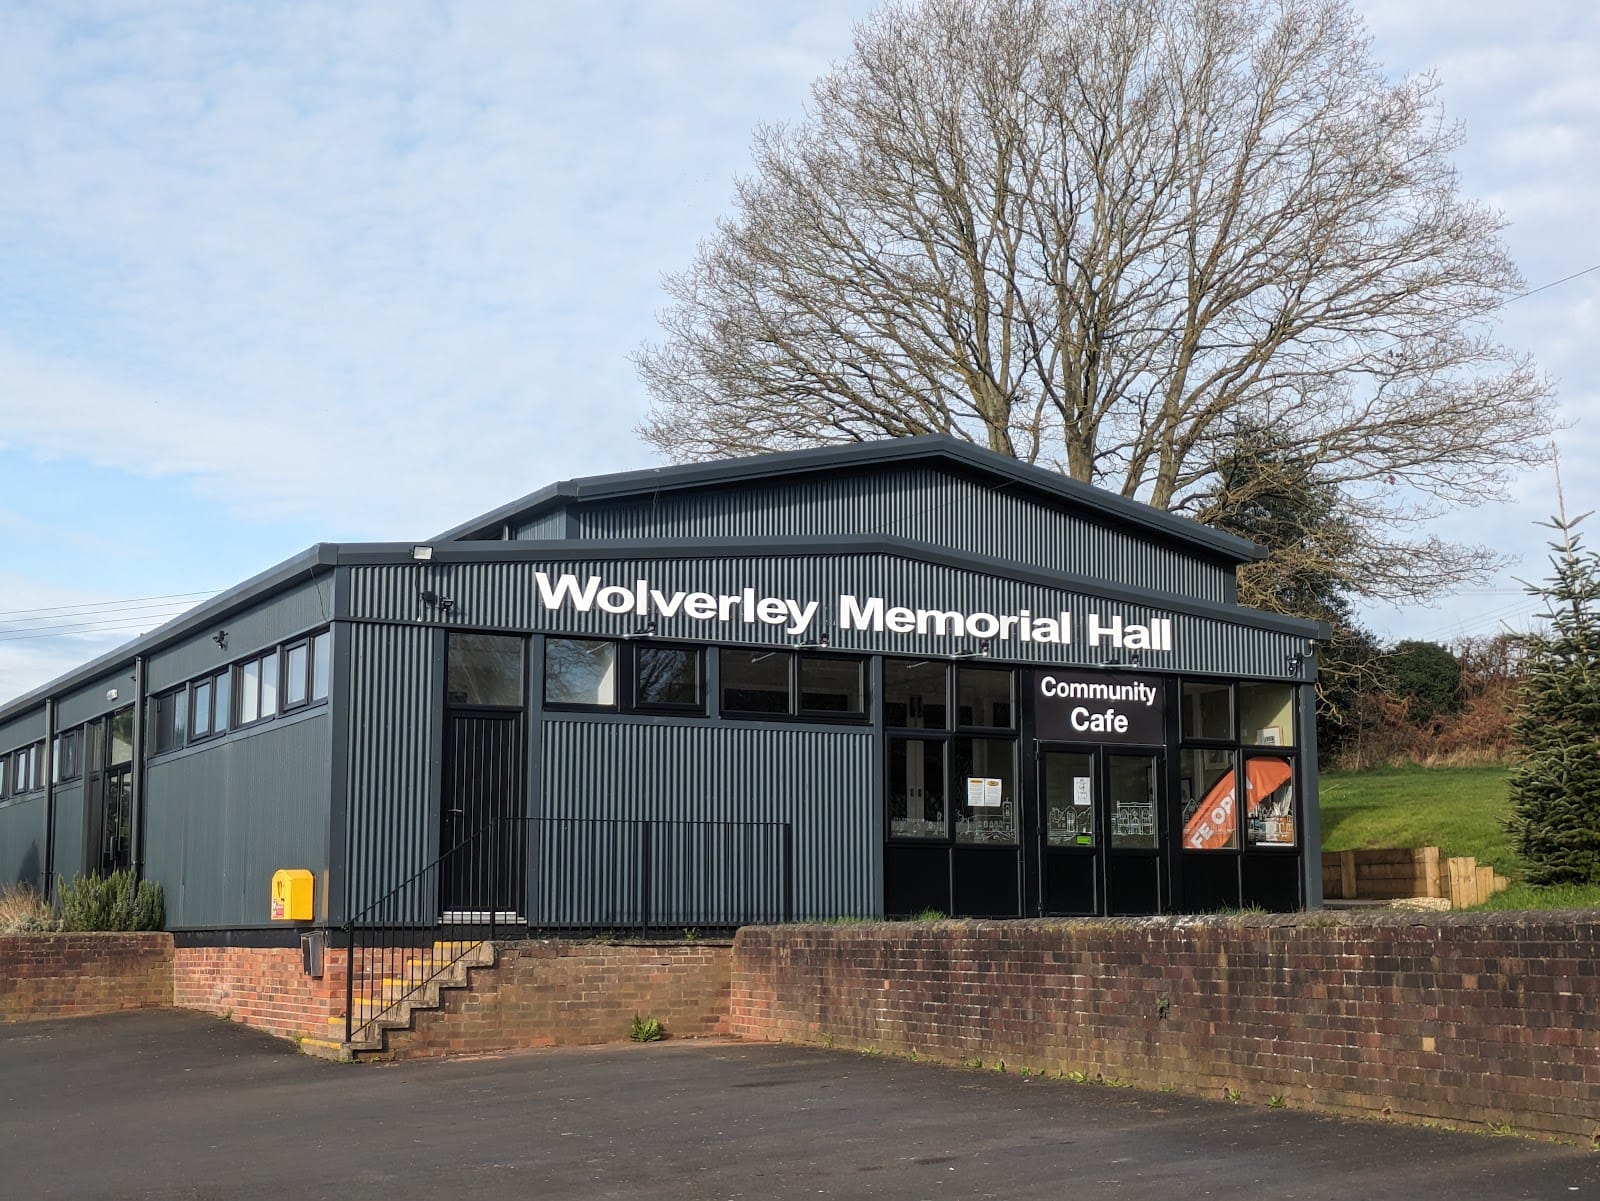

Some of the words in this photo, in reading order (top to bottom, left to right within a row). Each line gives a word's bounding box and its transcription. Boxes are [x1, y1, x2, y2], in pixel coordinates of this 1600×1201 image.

[535, 572, 818, 634] Wolverley
[840, 594, 1070, 644] Memorial
[1089, 613, 1171, 650] Hall
[1041, 676, 1156, 705] Community
[1071, 707, 1128, 732] Cafe
[1187, 821, 1214, 848] FE
[1211, 776, 1253, 825] OP
